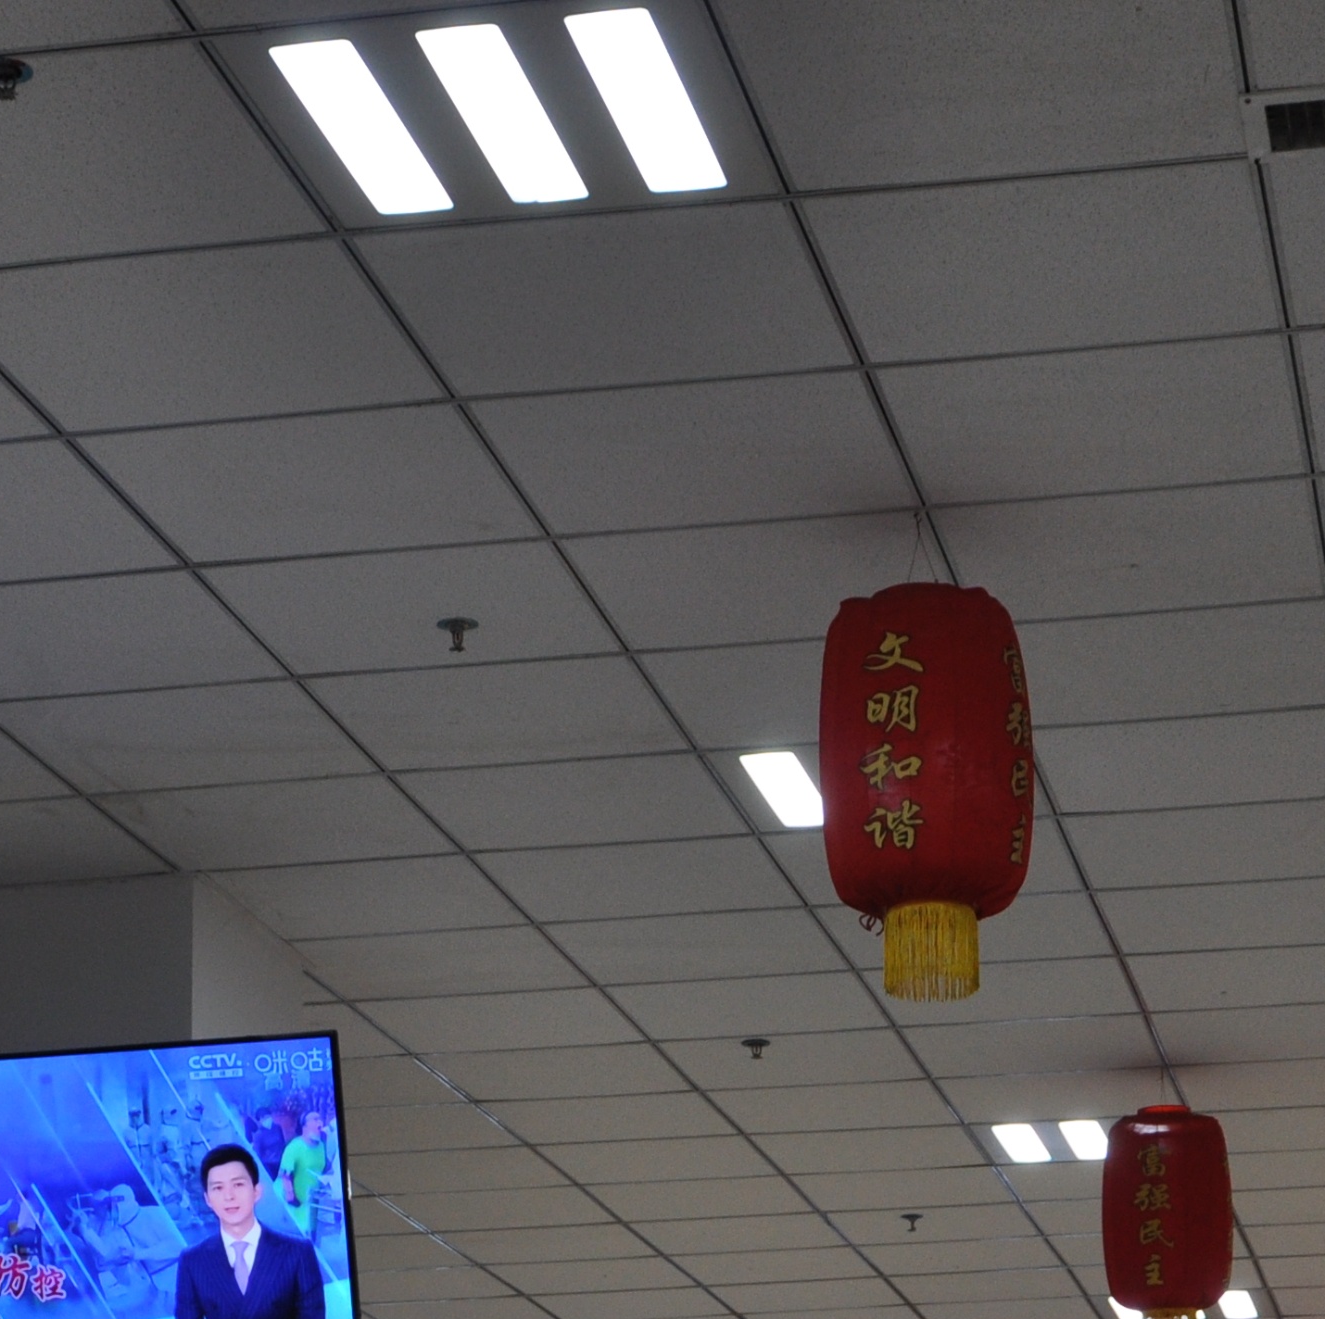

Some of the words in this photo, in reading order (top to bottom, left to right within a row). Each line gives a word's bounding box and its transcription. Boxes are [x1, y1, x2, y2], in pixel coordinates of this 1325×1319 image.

[858, 632, 925, 851] 文明和谐
[1133, 1144, 1175, 1287] 富强民主
